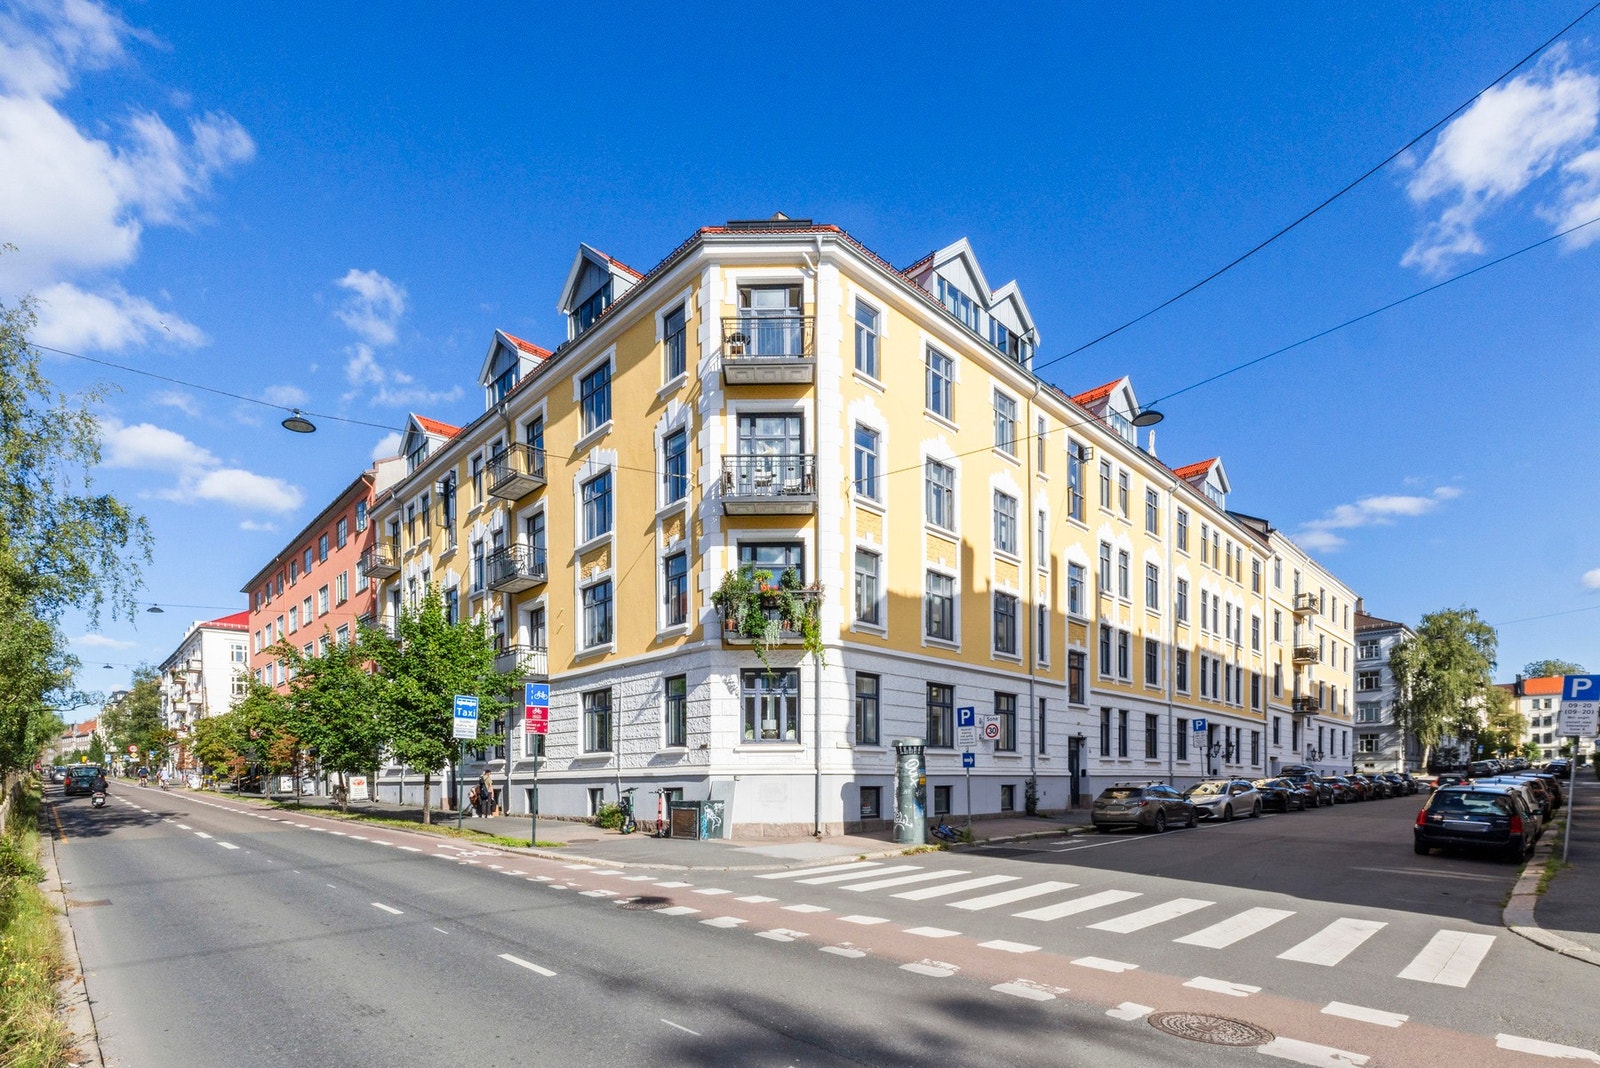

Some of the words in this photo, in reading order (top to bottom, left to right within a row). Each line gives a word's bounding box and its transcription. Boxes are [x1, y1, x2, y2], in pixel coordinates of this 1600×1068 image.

[1571, 678, 1593, 698] P
[456, 707, 476, 718] Taxi
[961, 709, 971, 725] P
[1195, 720, 1203, 730] P
[987, 727, 997, 735] 30
